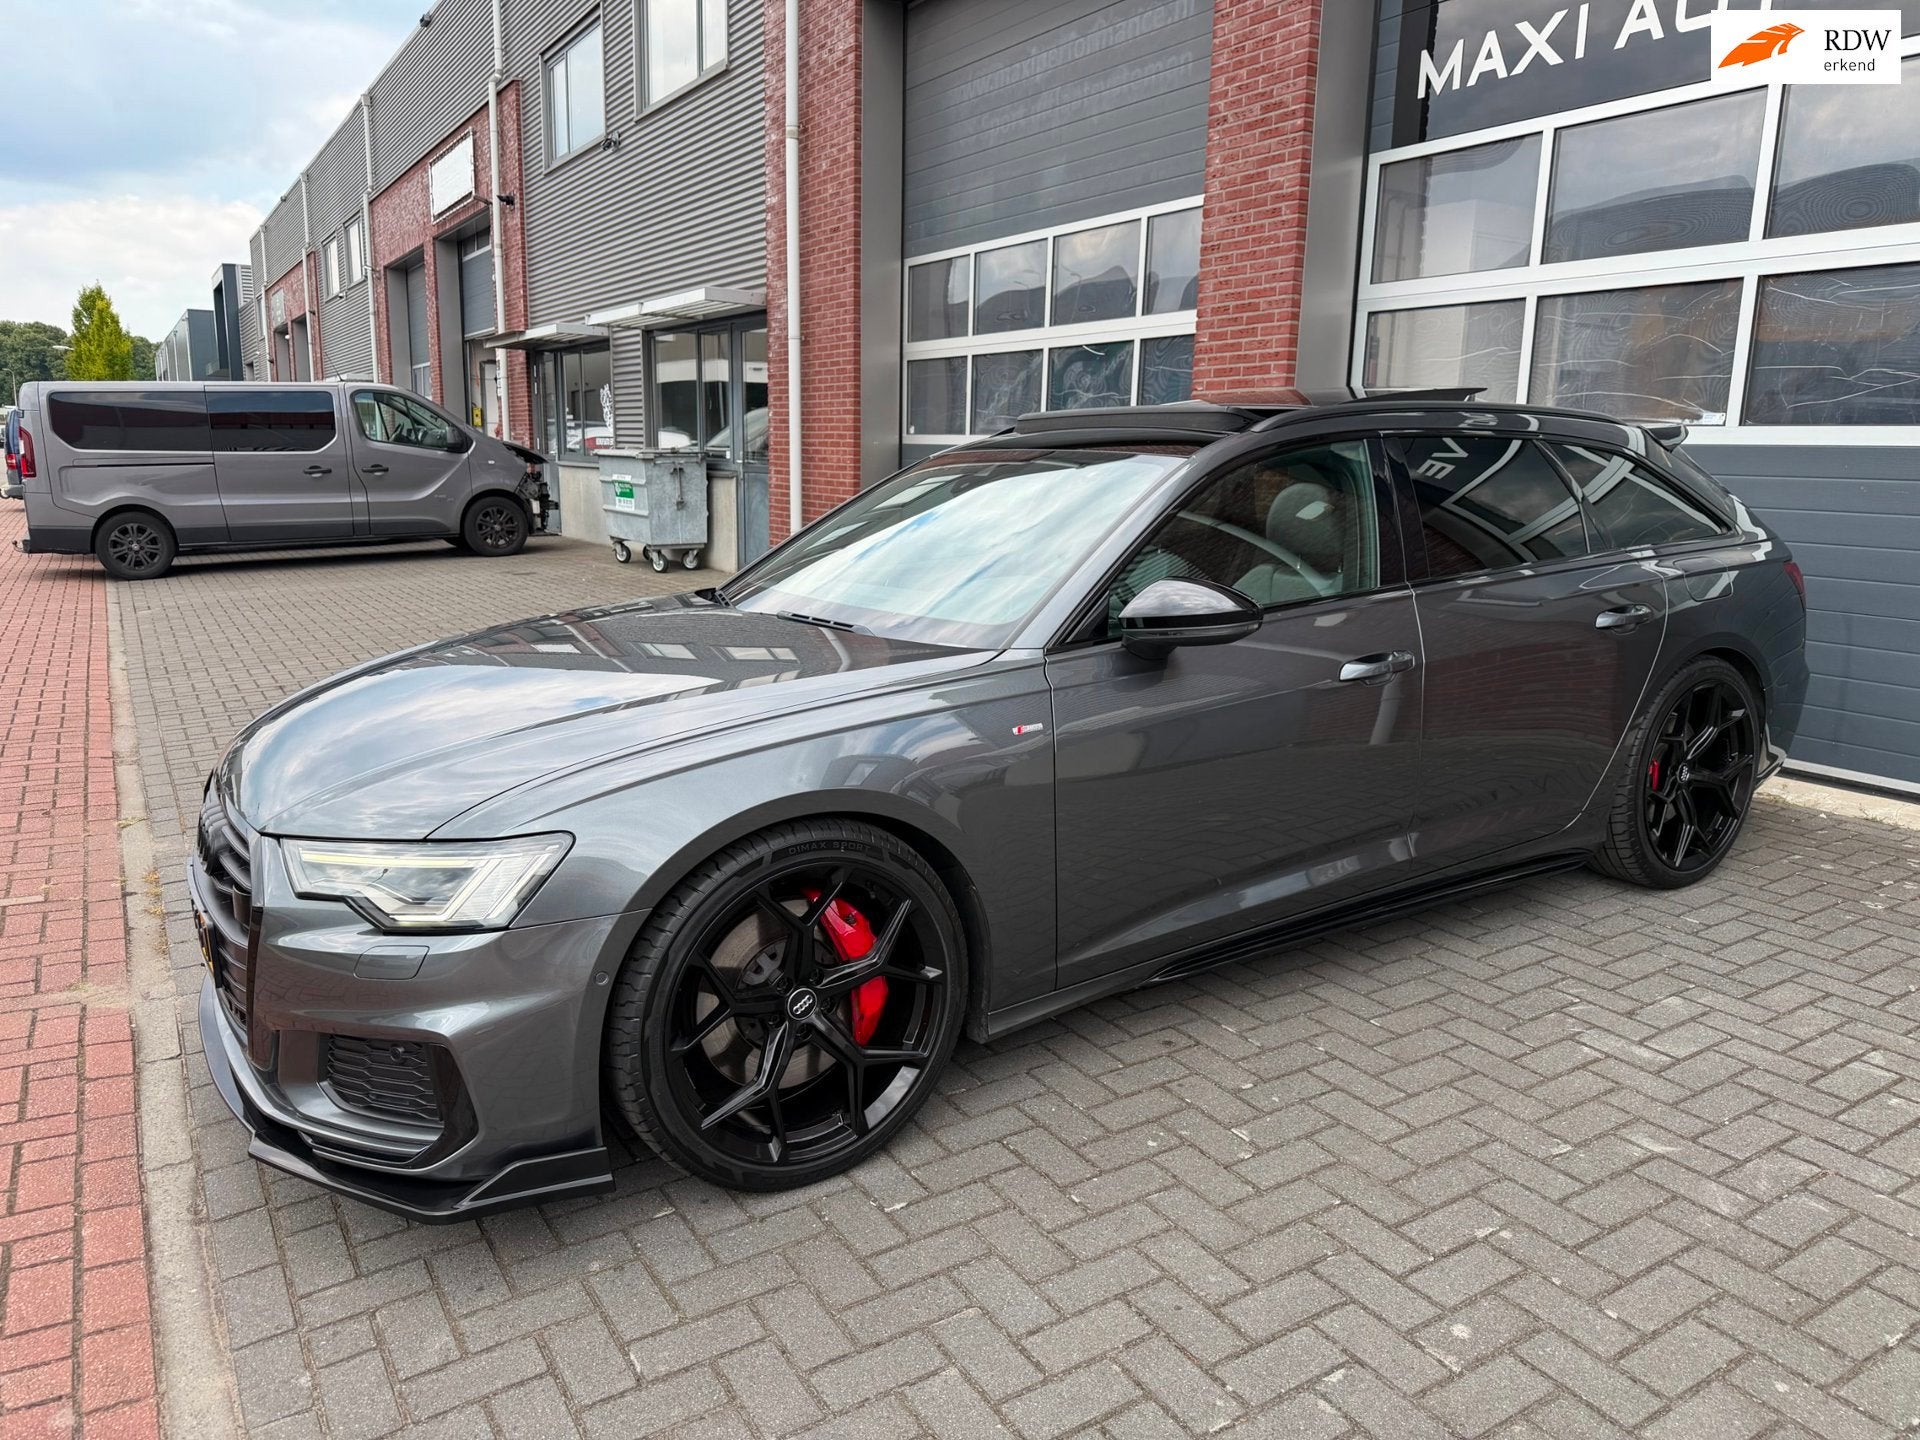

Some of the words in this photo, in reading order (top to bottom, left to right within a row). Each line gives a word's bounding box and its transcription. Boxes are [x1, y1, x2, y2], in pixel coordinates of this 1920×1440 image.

[1417, 2, 1590, 100] MAXI
[788, 841, 827, 855] DIMAX
[832, 841, 871, 852] SPORT
